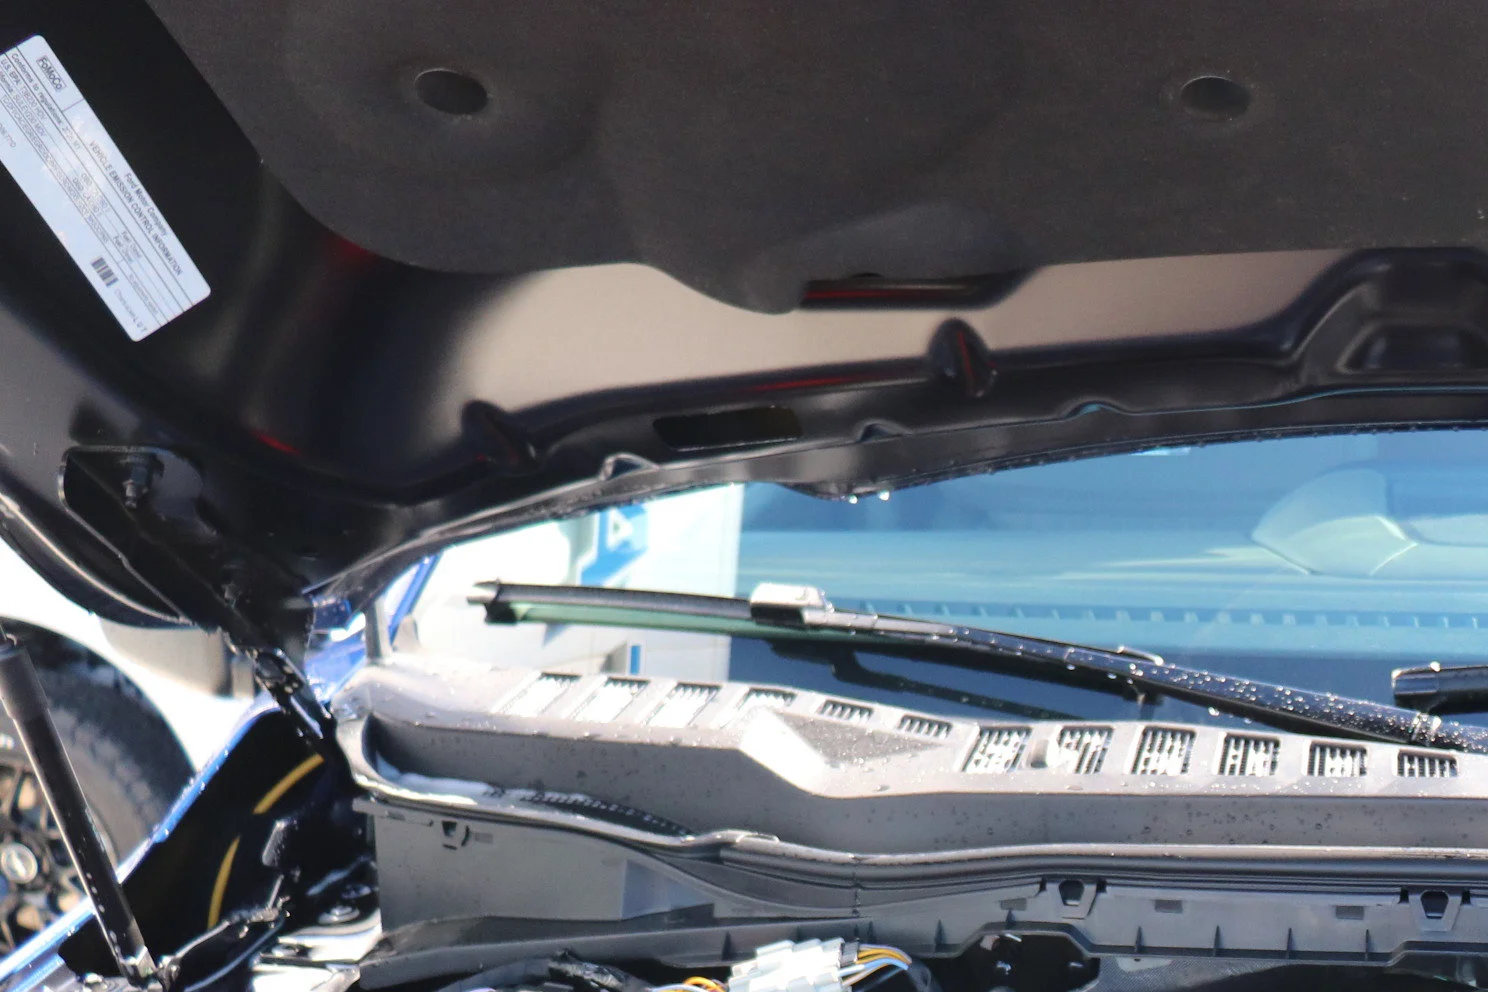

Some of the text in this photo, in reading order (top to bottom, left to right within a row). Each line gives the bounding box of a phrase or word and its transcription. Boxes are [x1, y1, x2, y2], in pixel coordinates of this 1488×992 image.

[10, 51, 35, 84] Conforms
[31, 82, 40, 91] to
[37, 56, 64, 91] FoMoCo
[88, 139, 183, 276] VEHICLE EMISSION CONTROL INFORMATION
[123, 172, 169, 237] Ford Motor Company
